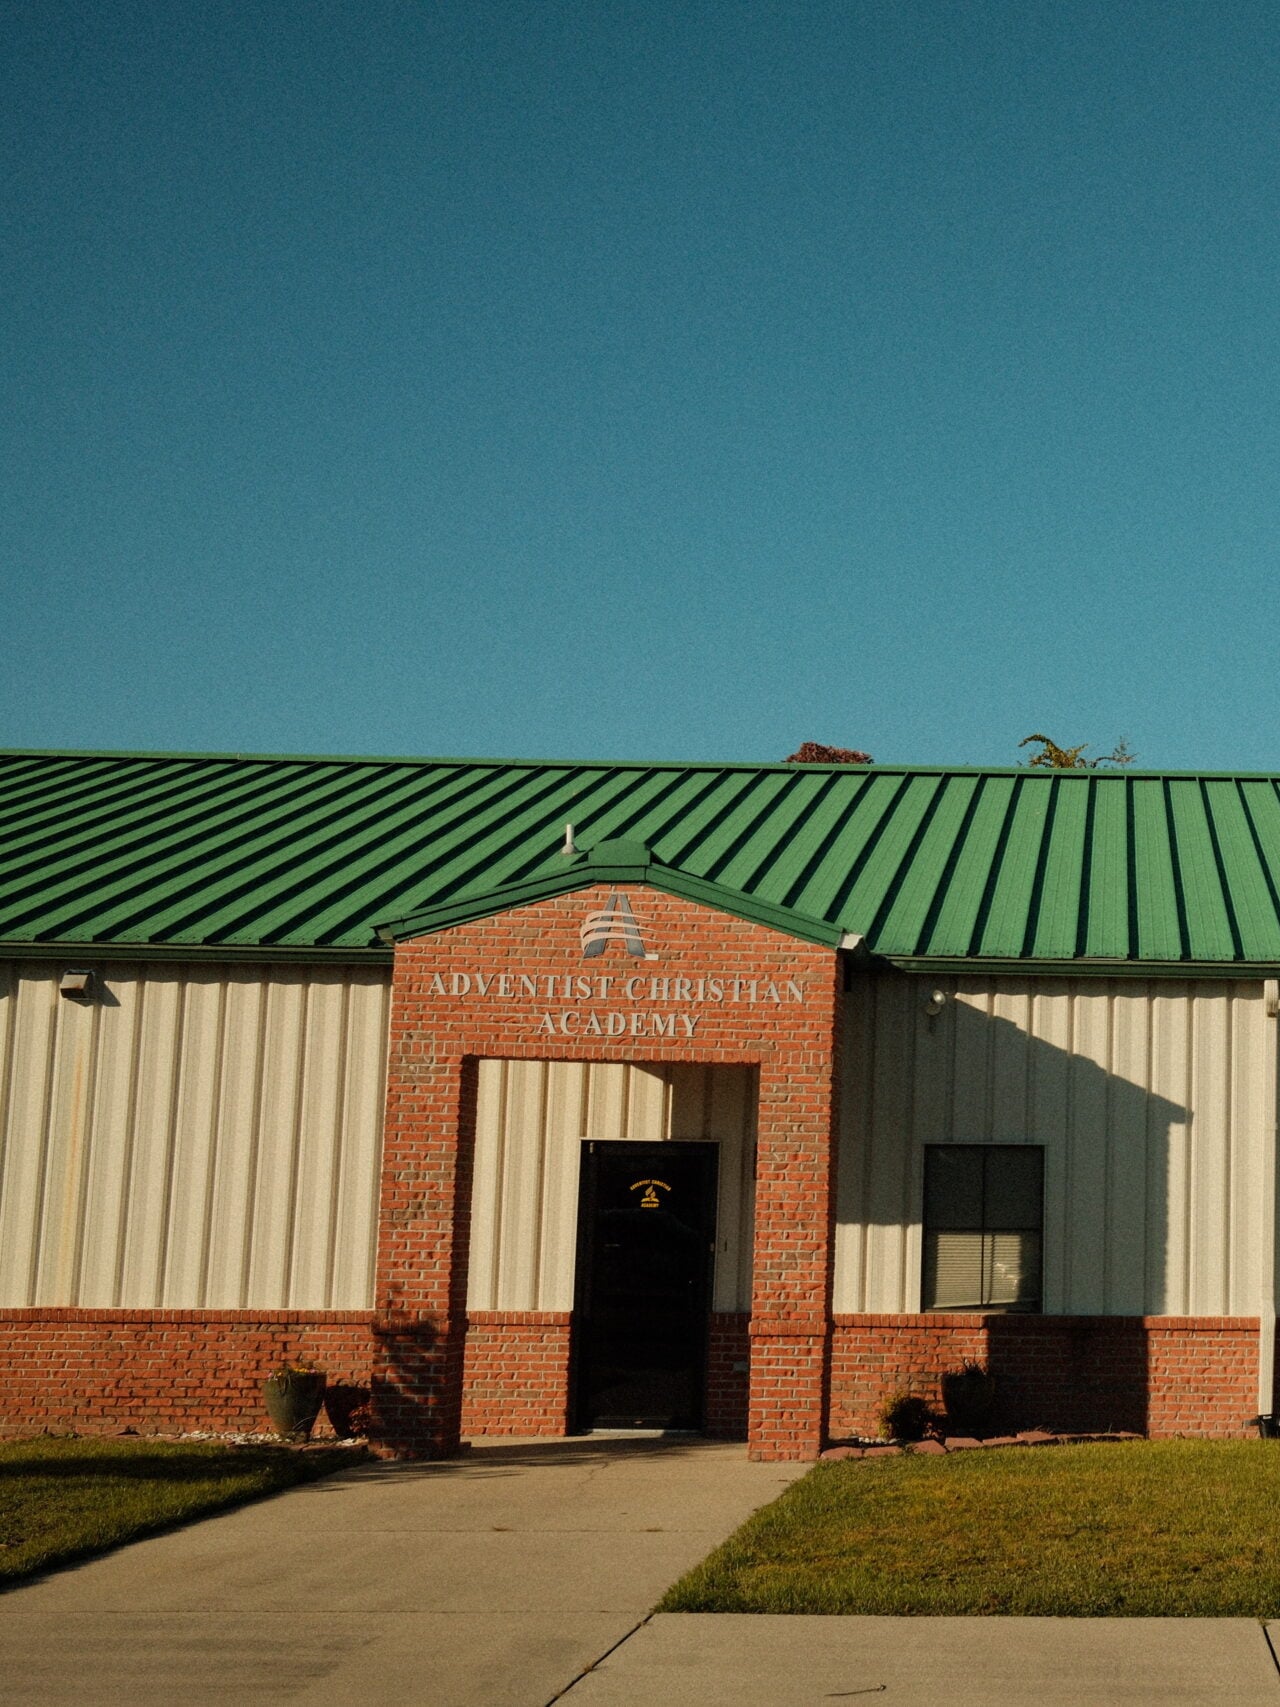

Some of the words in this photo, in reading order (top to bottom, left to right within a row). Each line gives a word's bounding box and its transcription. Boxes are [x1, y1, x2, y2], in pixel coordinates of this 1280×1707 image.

[428, 973, 614, 1000] ADVENTIST
[625, 976, 805, 1004] CHRISTIAN
[537, 1009, 701, 1038] ACADEMY
